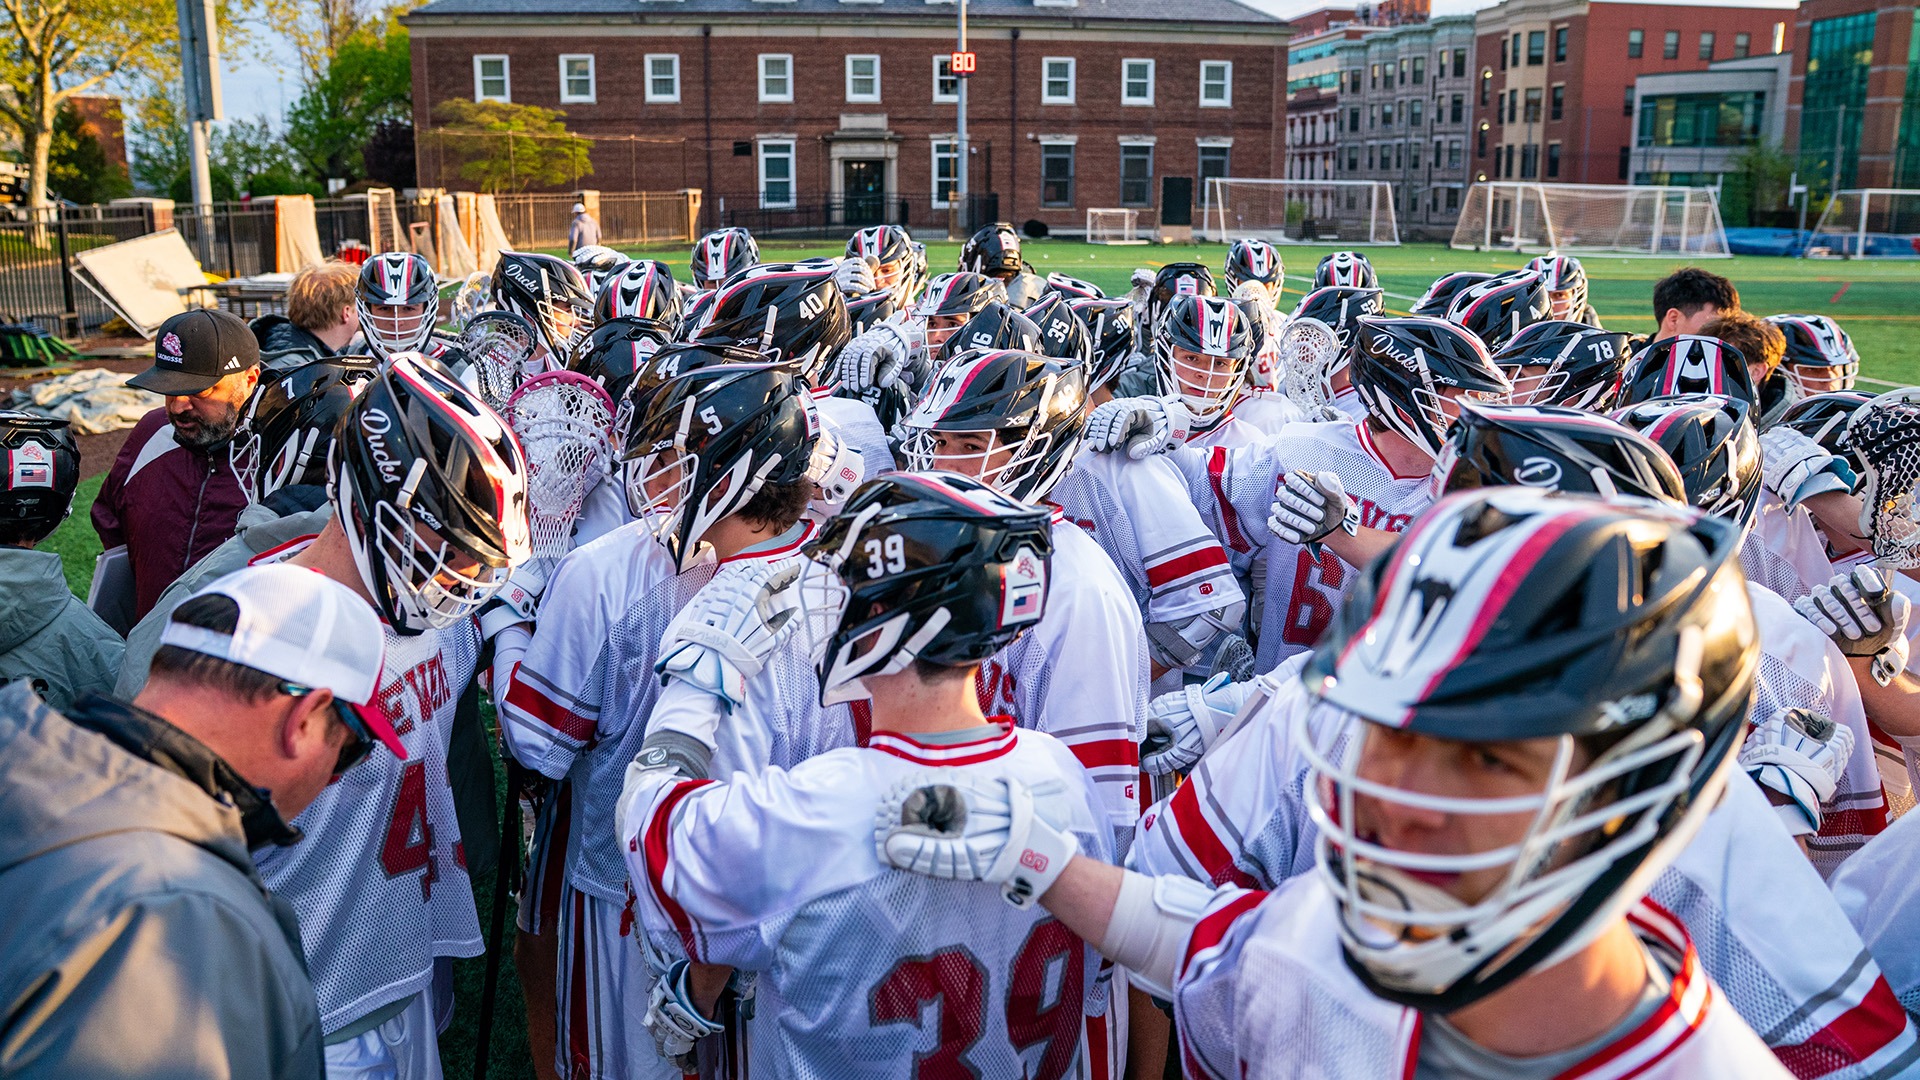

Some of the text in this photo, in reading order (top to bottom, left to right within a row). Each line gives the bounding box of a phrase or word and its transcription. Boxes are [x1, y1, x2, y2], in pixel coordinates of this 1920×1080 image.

[952, 52, 976, 72] 80
[504, 263, 540, 293] Ducks
[799, 292, 825, 320] 40
[1360, 298, 1380, 315] 52
[1047, 317, 1070, 343] 35
[1112, 313, 1129, 334] 30
[157, 352, 184, 364] LACROSSE
[578, 335, 595, 360] 53
[1370, 333, 1420, 373] Ducks
[1587, 340, 1615, 362] 78
[656, 354, 682, 380] 44
[281, 376, 296, 400] 7
[699, 405, 724, 436] 5
[360, 407, 402, 484] Ducks
[864, 533, 907, 580] 39
[1282, 548, 1347, 648] 6
[867, 913, 1084, 1080] 39
